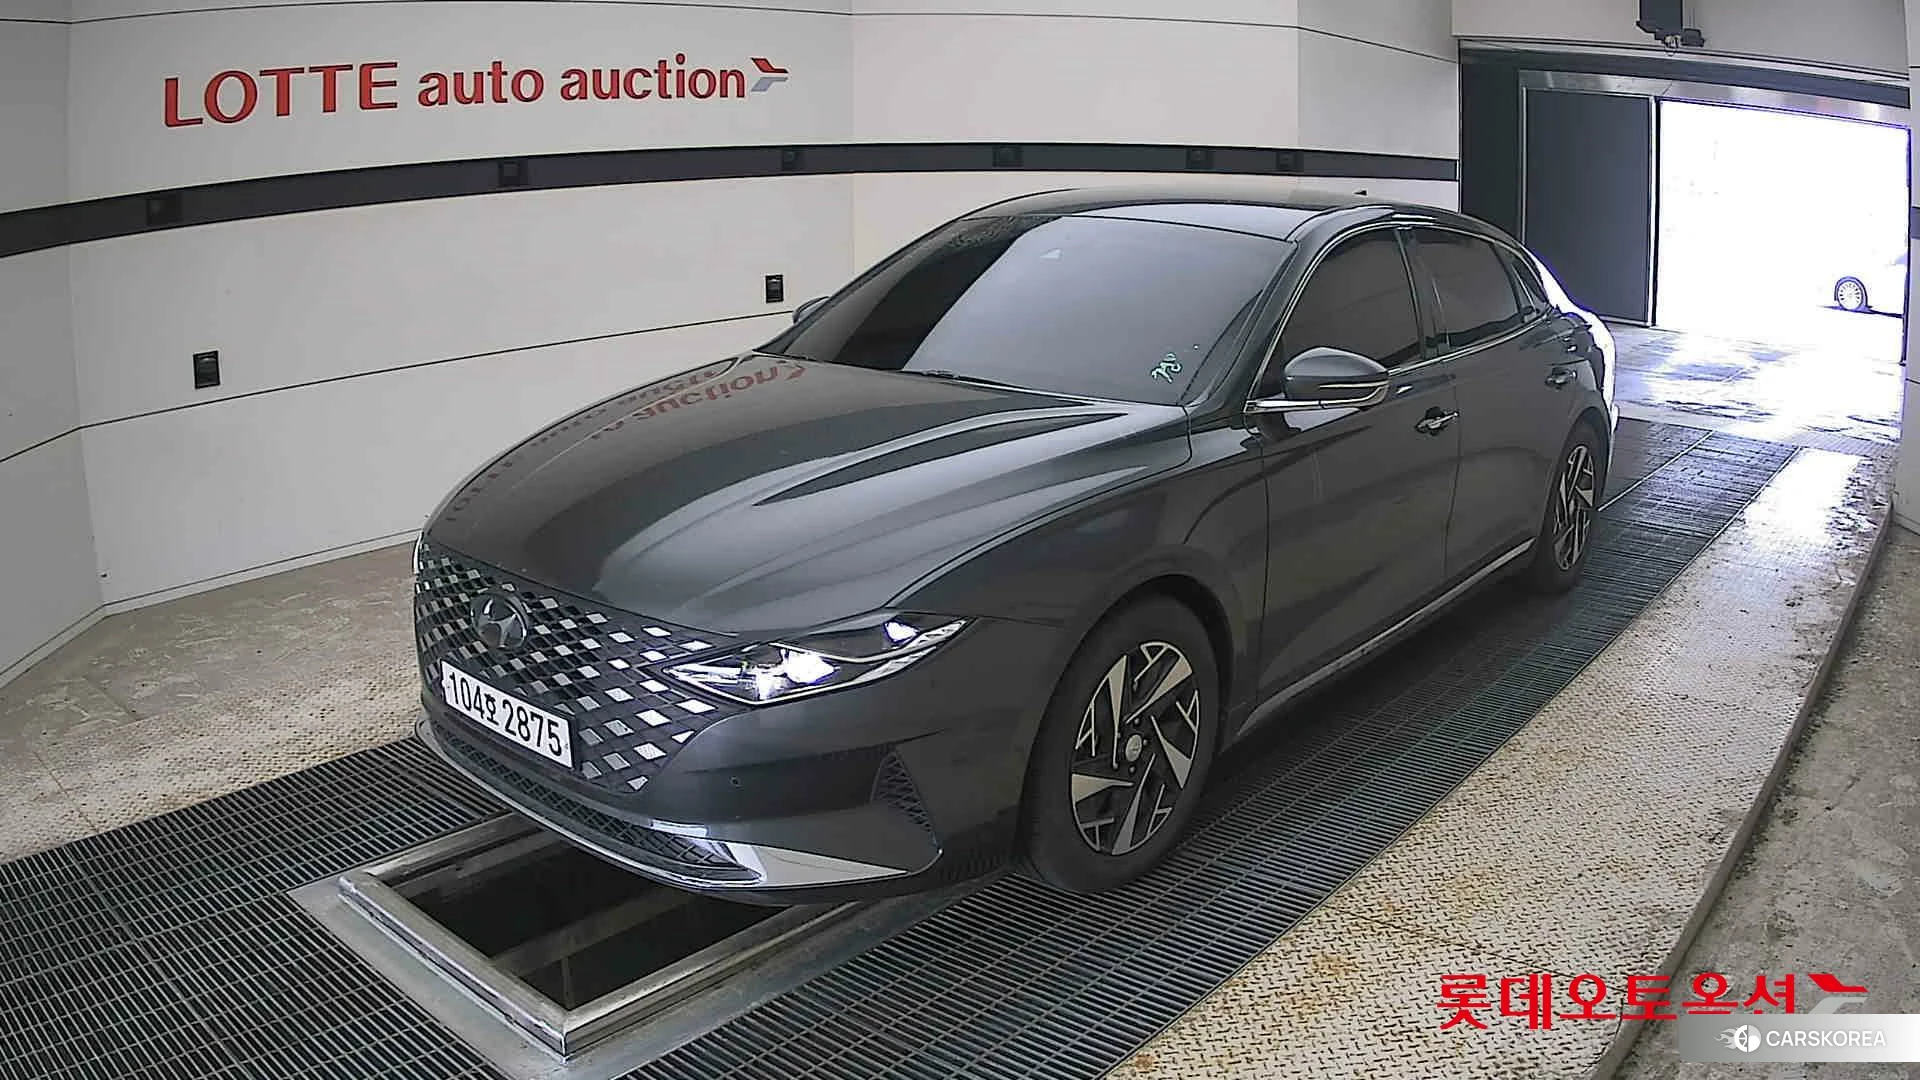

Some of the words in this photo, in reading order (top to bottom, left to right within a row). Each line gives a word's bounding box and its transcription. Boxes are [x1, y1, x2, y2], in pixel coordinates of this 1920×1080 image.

[163, 61, 398, 127] LOTTE
[417, 60, 545, 107] auto
[559, 53, 745, 100] auction
[450, 671, 500, 726] 104호
[503, 699, 562, 757] 2875
